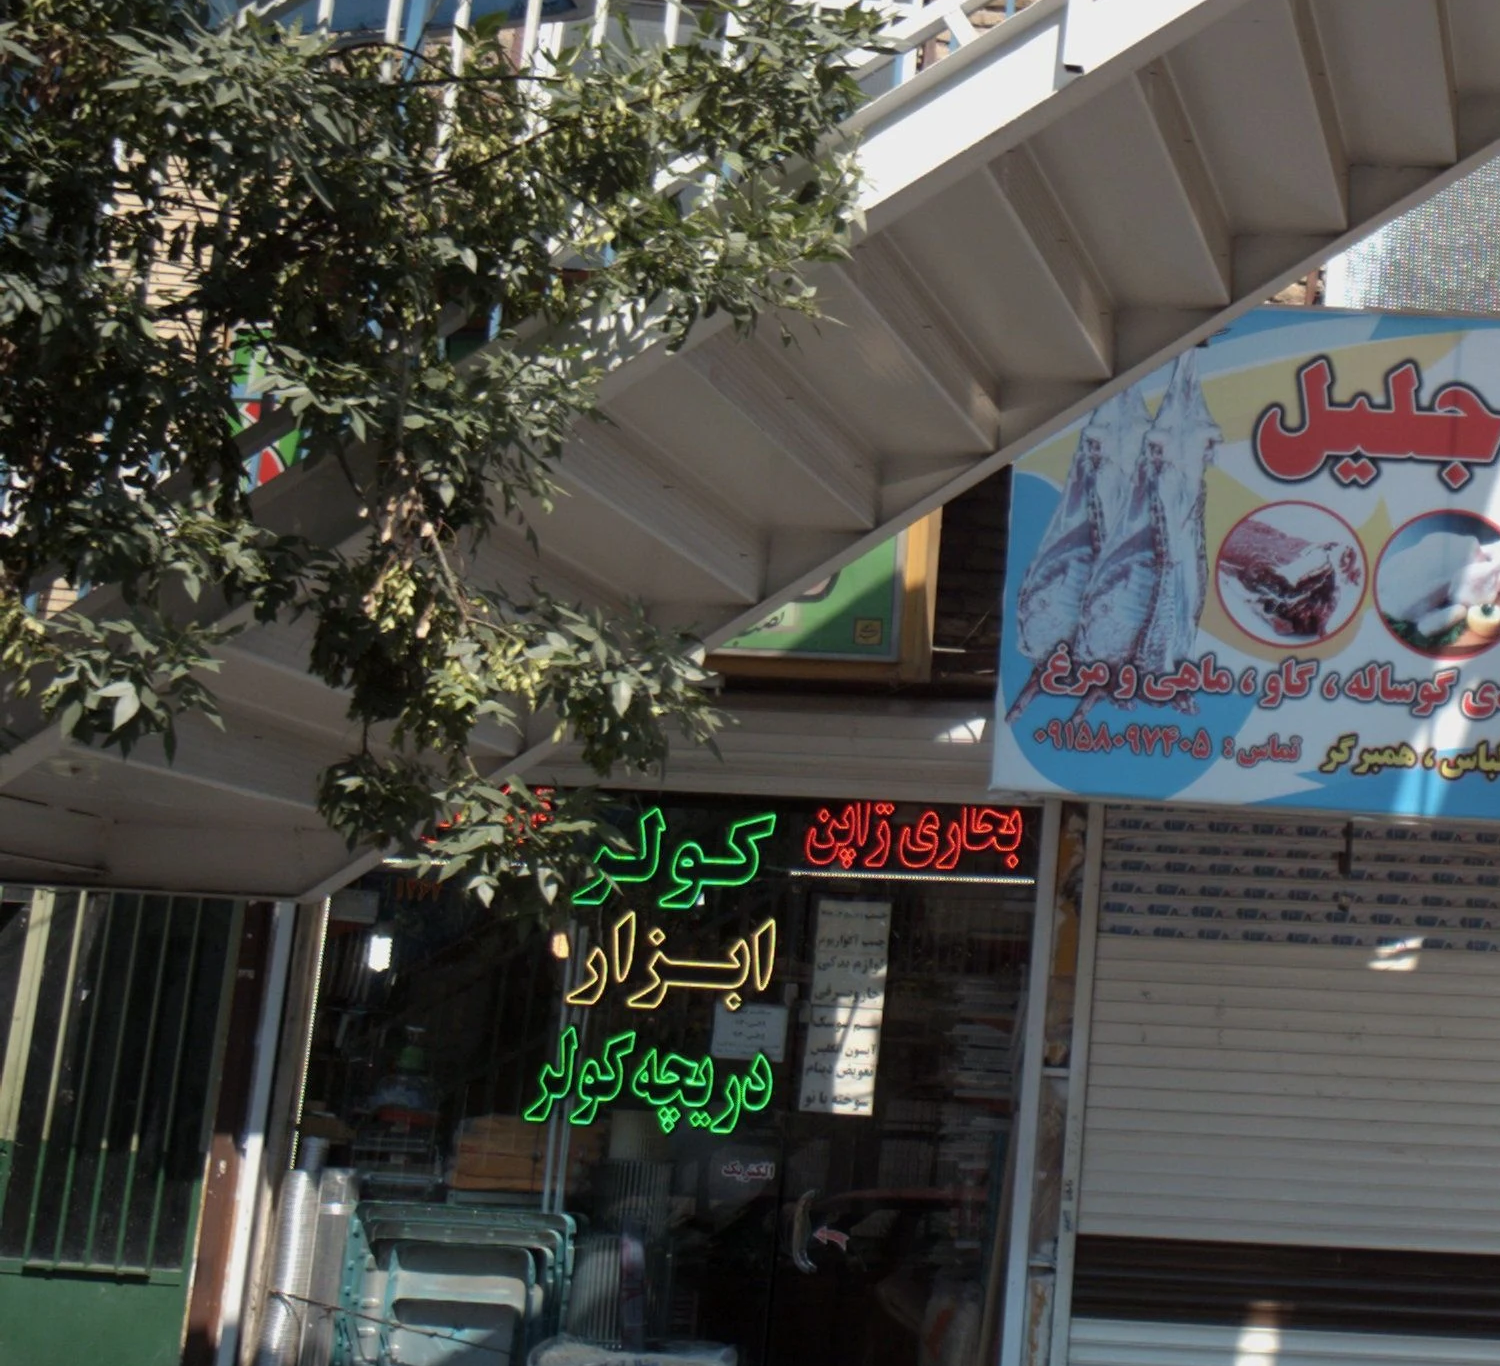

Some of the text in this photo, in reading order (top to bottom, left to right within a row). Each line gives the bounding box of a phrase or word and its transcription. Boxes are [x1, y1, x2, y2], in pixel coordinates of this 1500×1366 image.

[1040, 642, 1111, 696] مرغ
[1114, 664, 1138, 699] و
[1142, 652, 1235, 701] ماهی
[1033, 719, 1214, 759] ۰۹۱۵۸۰۹۷۴۰۵
[1318, 732, 1418, 775] همبرگر
[571, 806, 778, 910] کولر
[566, 911, 778, 1012] ابزار
[523, 1026, 637, 1126] کولر
[632, 1044, 775, 1135] دریچه
